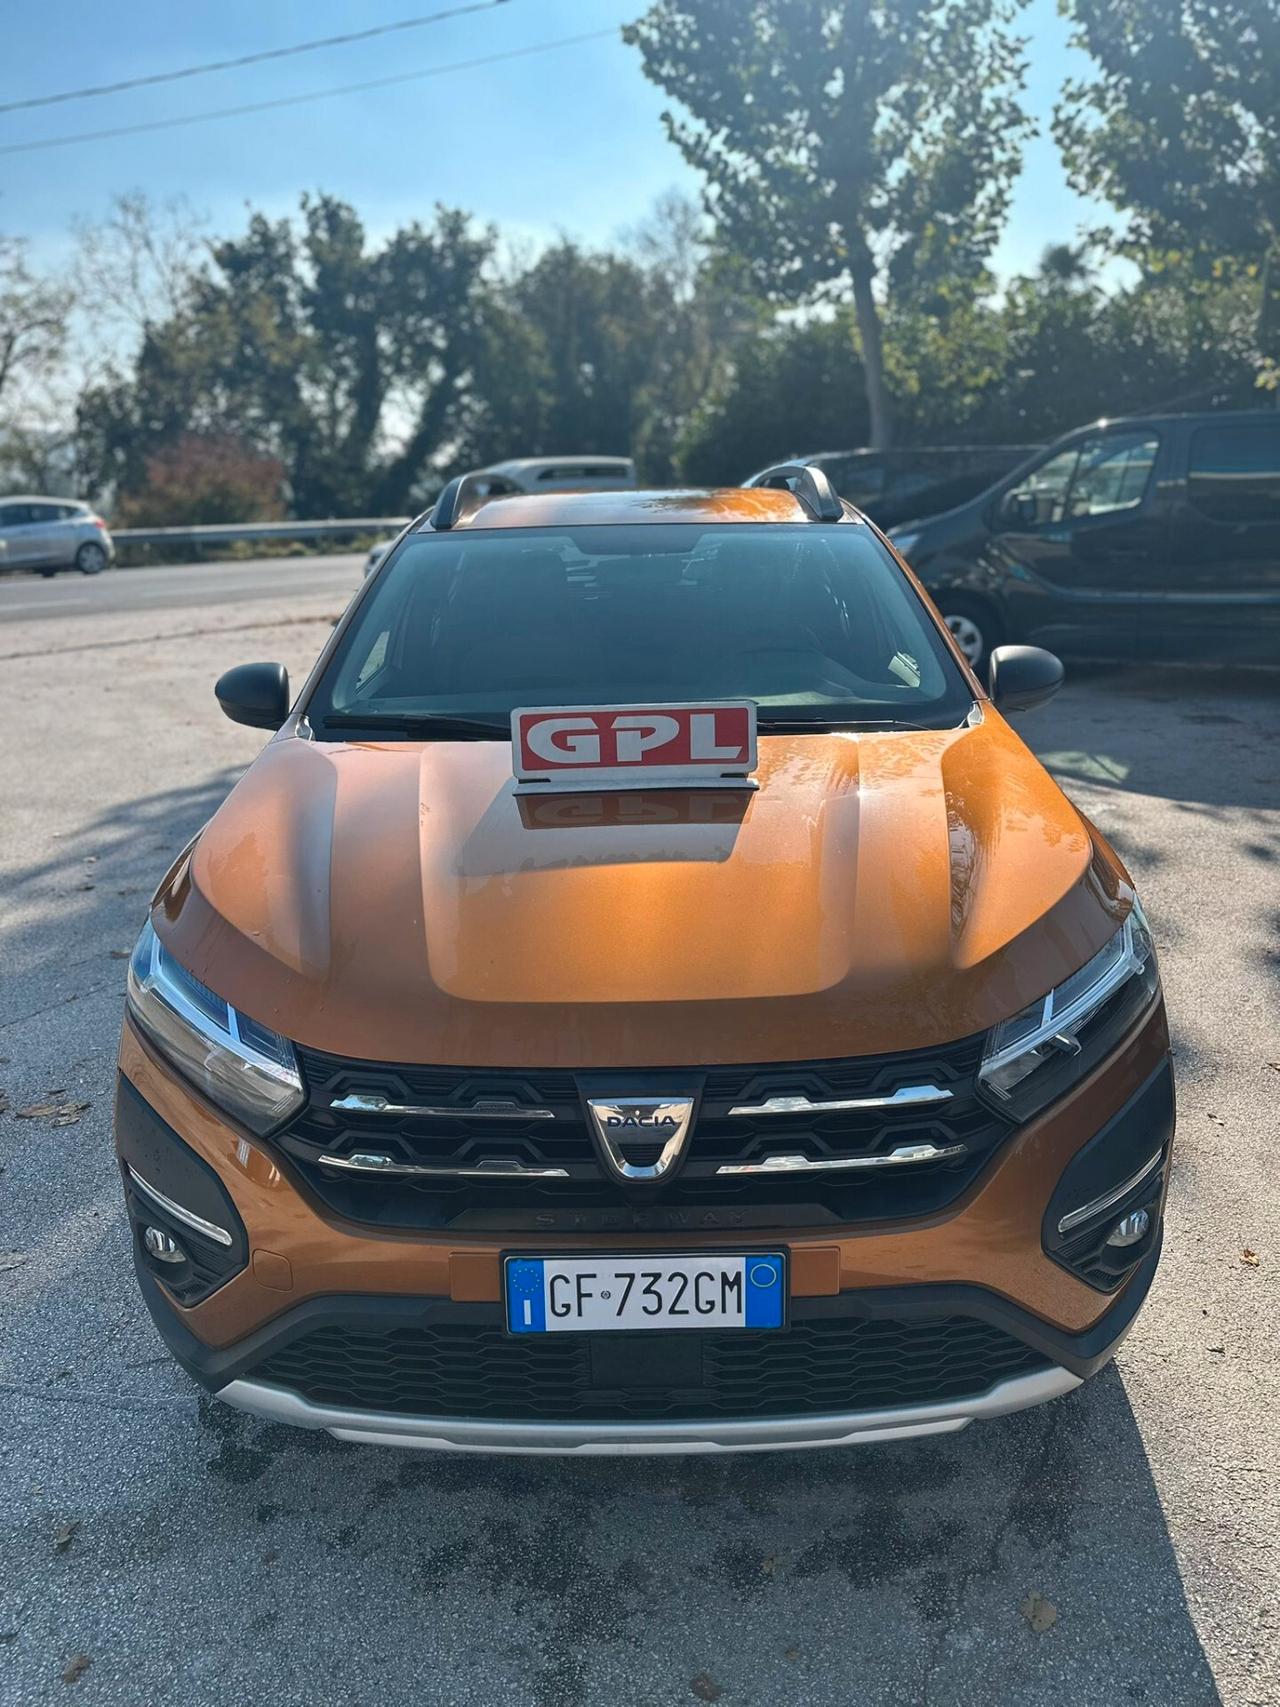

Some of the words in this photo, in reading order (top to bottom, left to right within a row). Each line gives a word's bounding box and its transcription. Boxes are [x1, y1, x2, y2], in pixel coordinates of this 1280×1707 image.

[526, 713, 743, 764] GPL
[607, 1115, 676, 1128] DACIA
[550, 1273, 597, 1318] GF
[614, 1271, 743, 1317] 732GM
